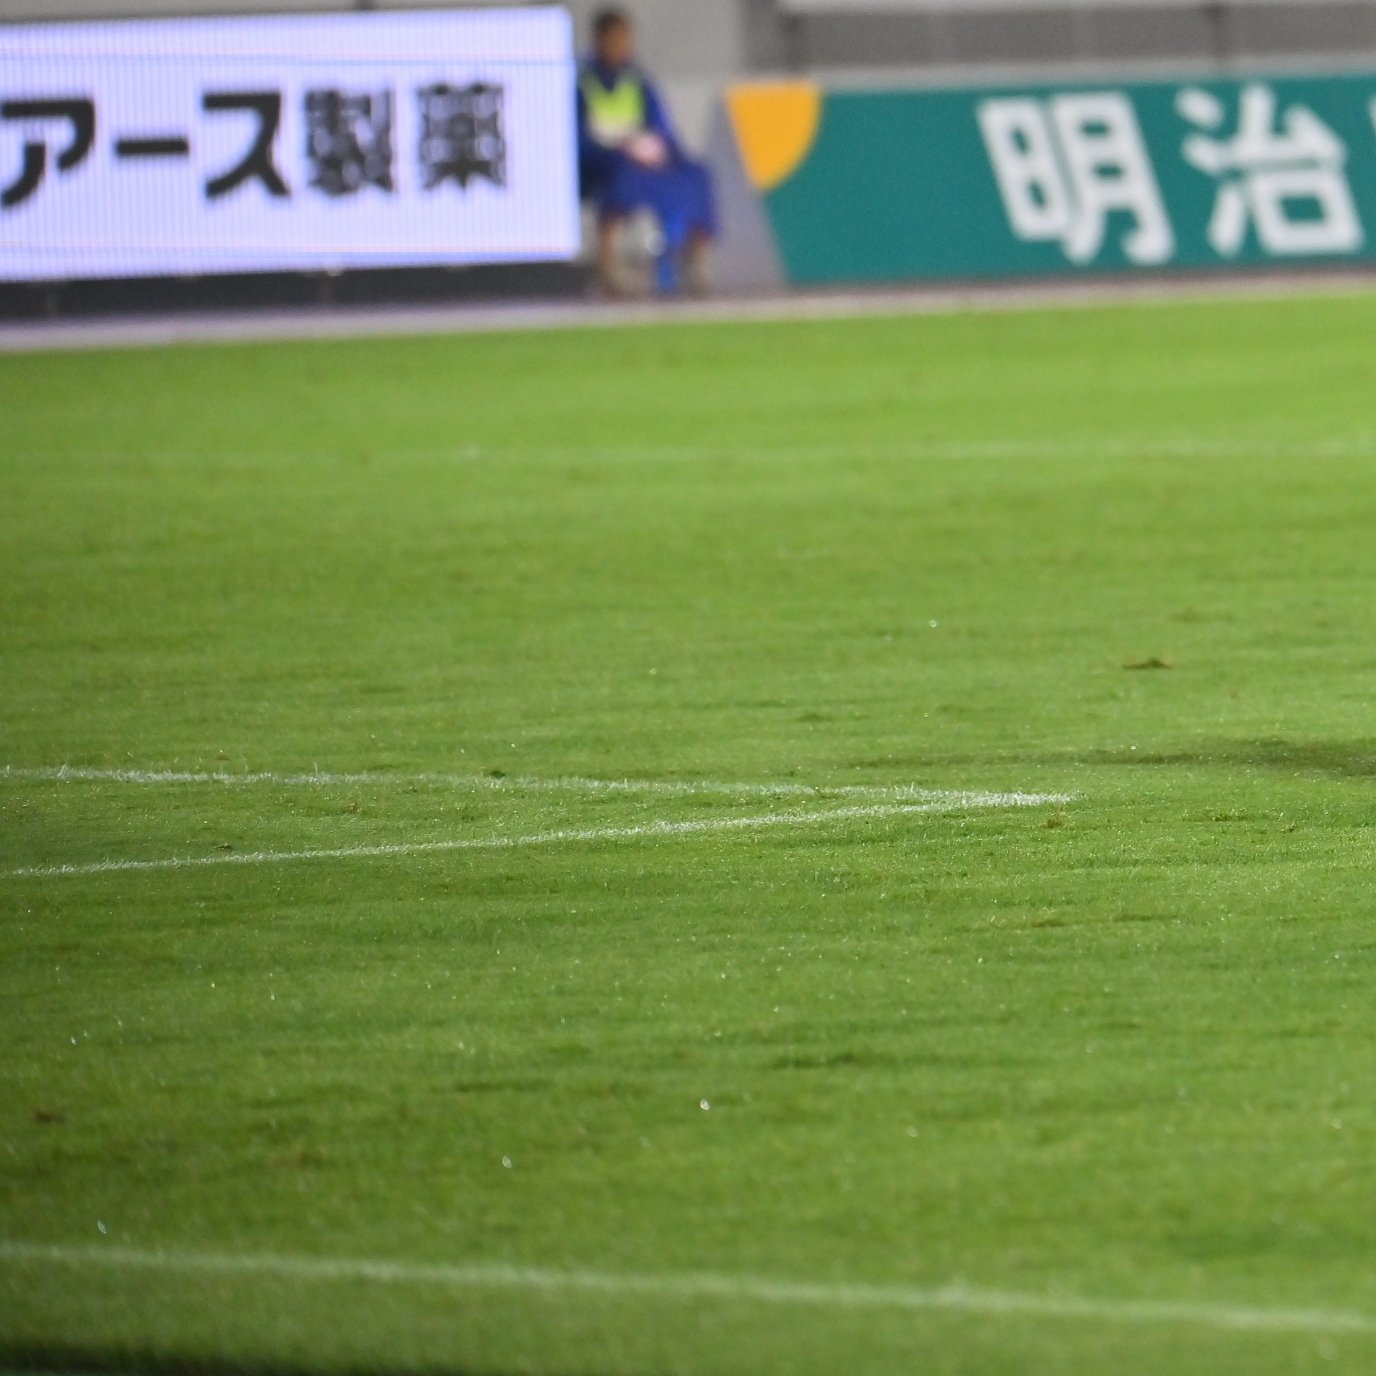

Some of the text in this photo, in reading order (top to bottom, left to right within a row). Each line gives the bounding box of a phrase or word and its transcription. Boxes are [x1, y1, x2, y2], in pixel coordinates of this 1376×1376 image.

[0, 80, 507, 207] アース製薬
